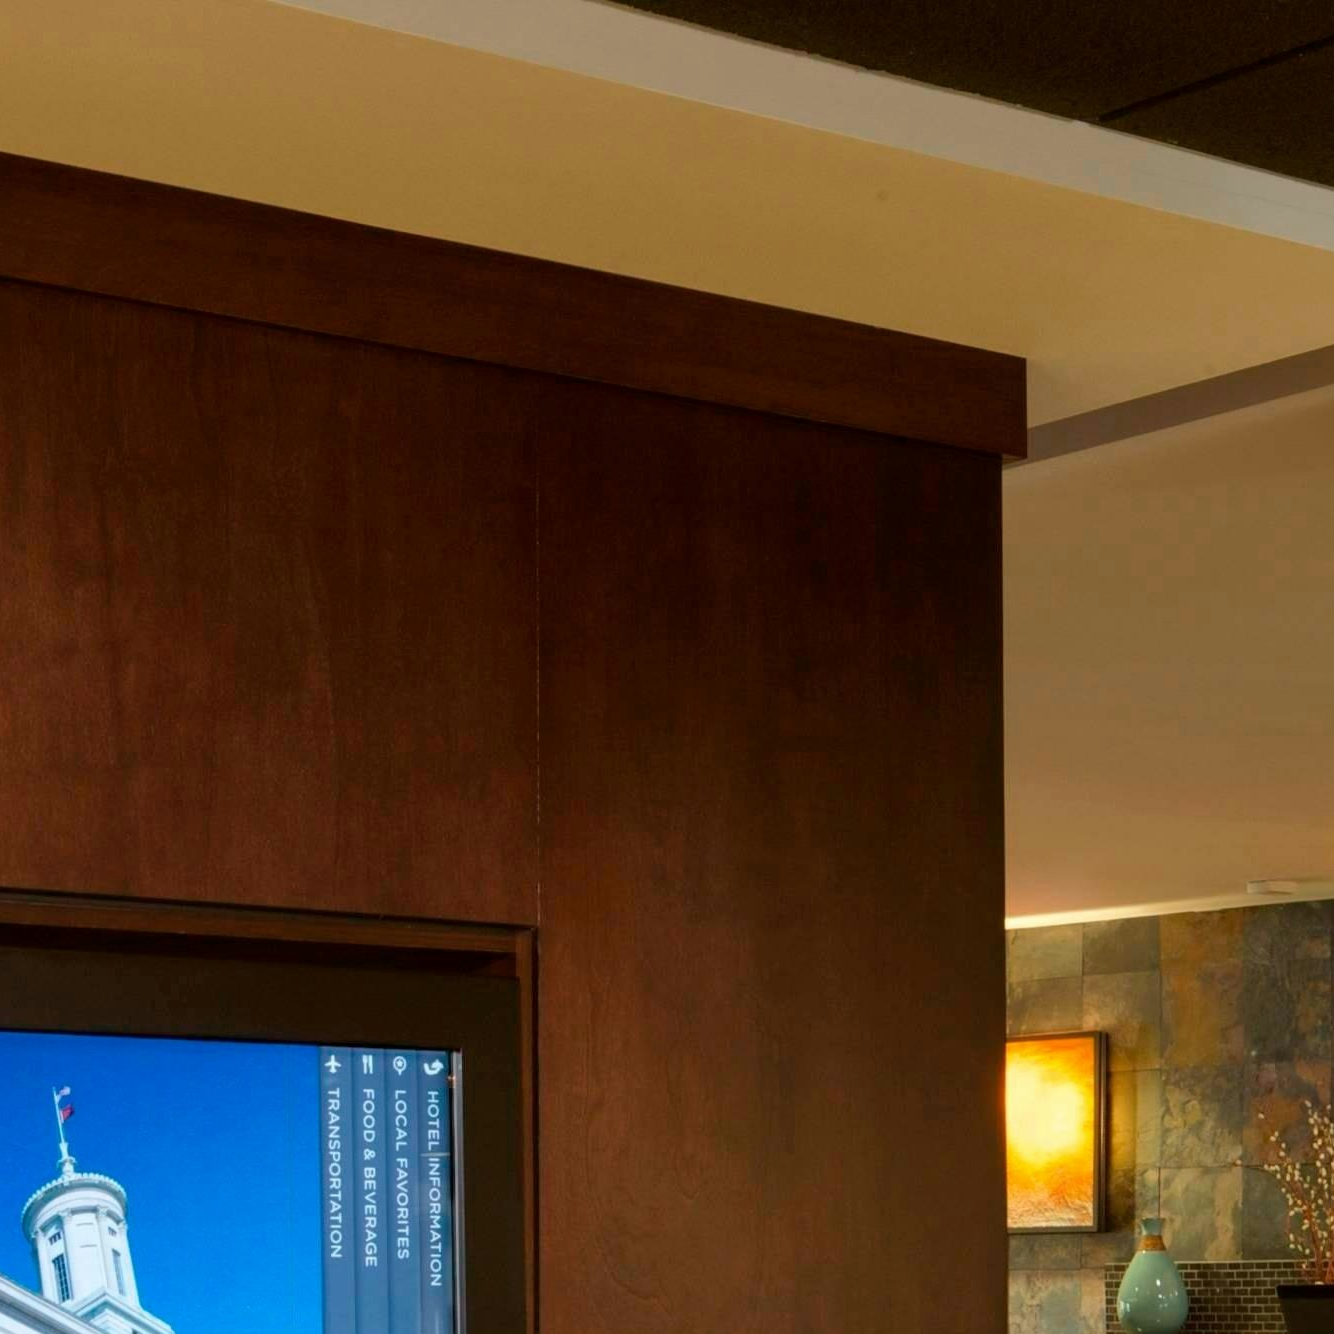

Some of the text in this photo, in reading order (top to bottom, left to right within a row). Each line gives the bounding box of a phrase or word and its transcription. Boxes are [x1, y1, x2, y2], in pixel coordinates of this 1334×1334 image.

[327, 1087, 343, 1258] TRANSPORTATION
[363, 1088, 379, 1268] FOOD & BEVERAGE
[395, 1089, 410, 1260] LOCAL FAVORITES
[427, 1090, 443, 1287] HOTEL INFORMATION
